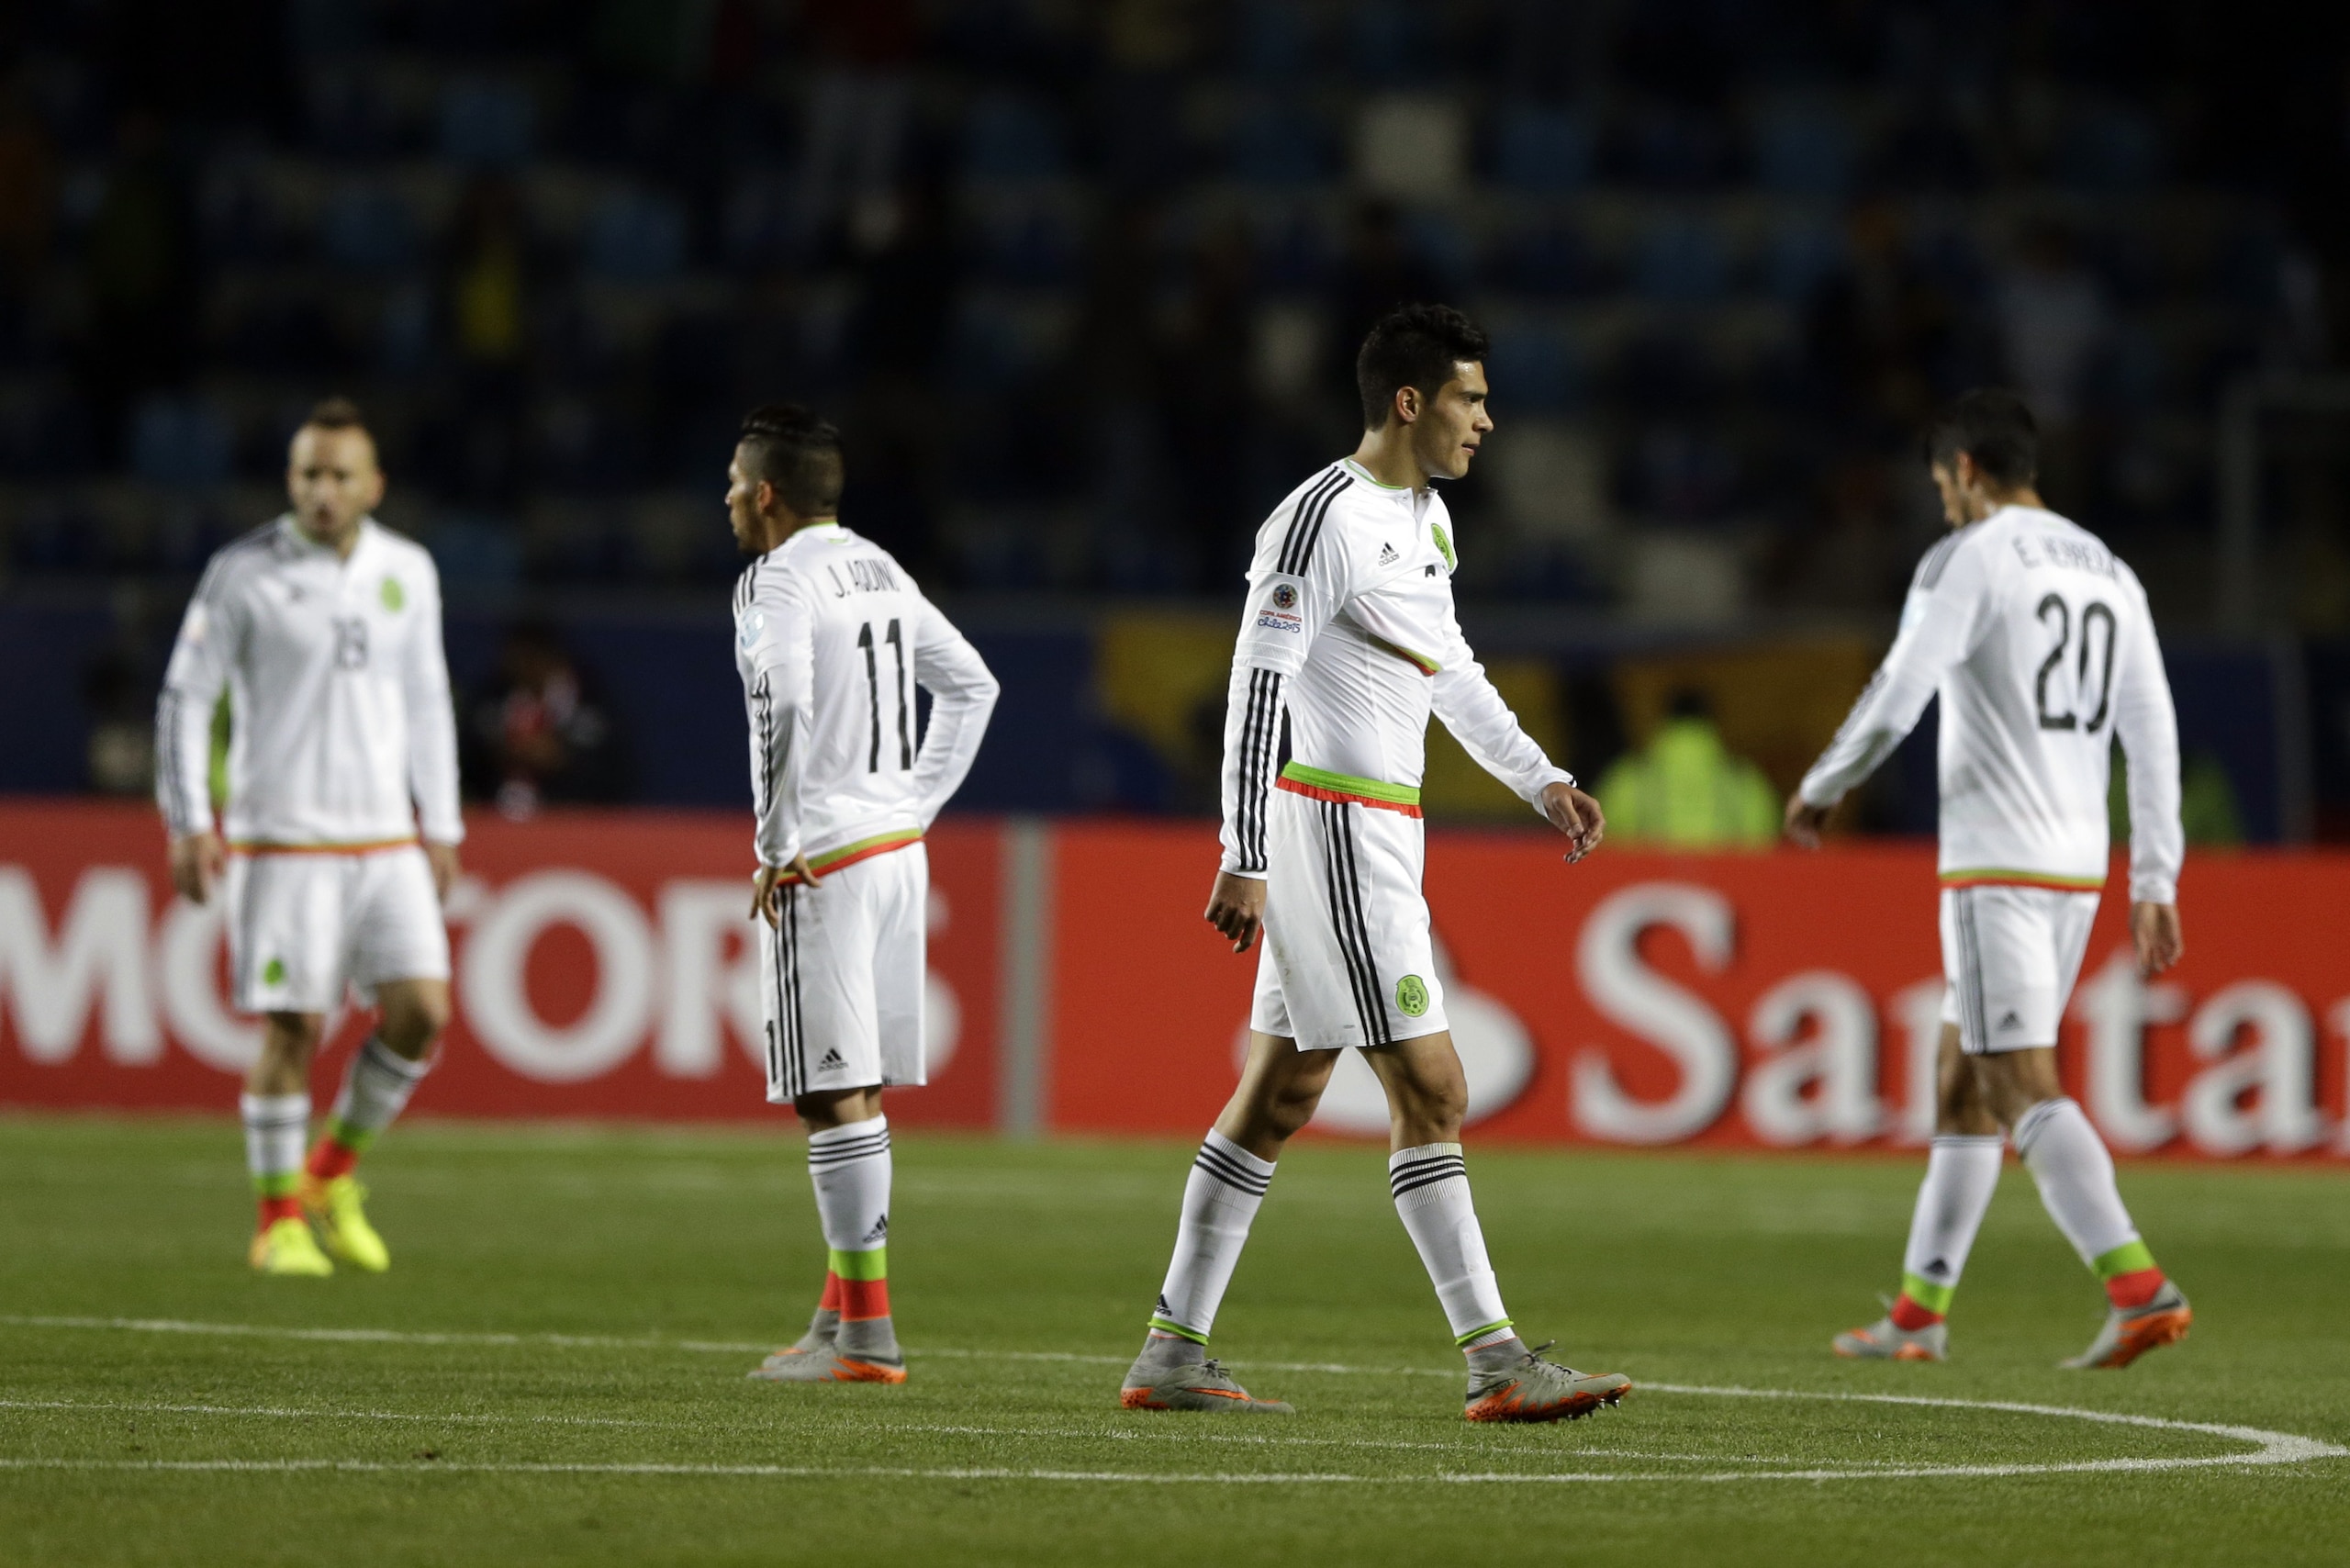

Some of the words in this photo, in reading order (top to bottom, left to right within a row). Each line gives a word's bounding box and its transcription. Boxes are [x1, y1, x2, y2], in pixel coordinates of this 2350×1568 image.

[826, 564, 851, 598] J.
[856, 619, 912, 774] 11
[2035, 592, 2117, 734] 20
